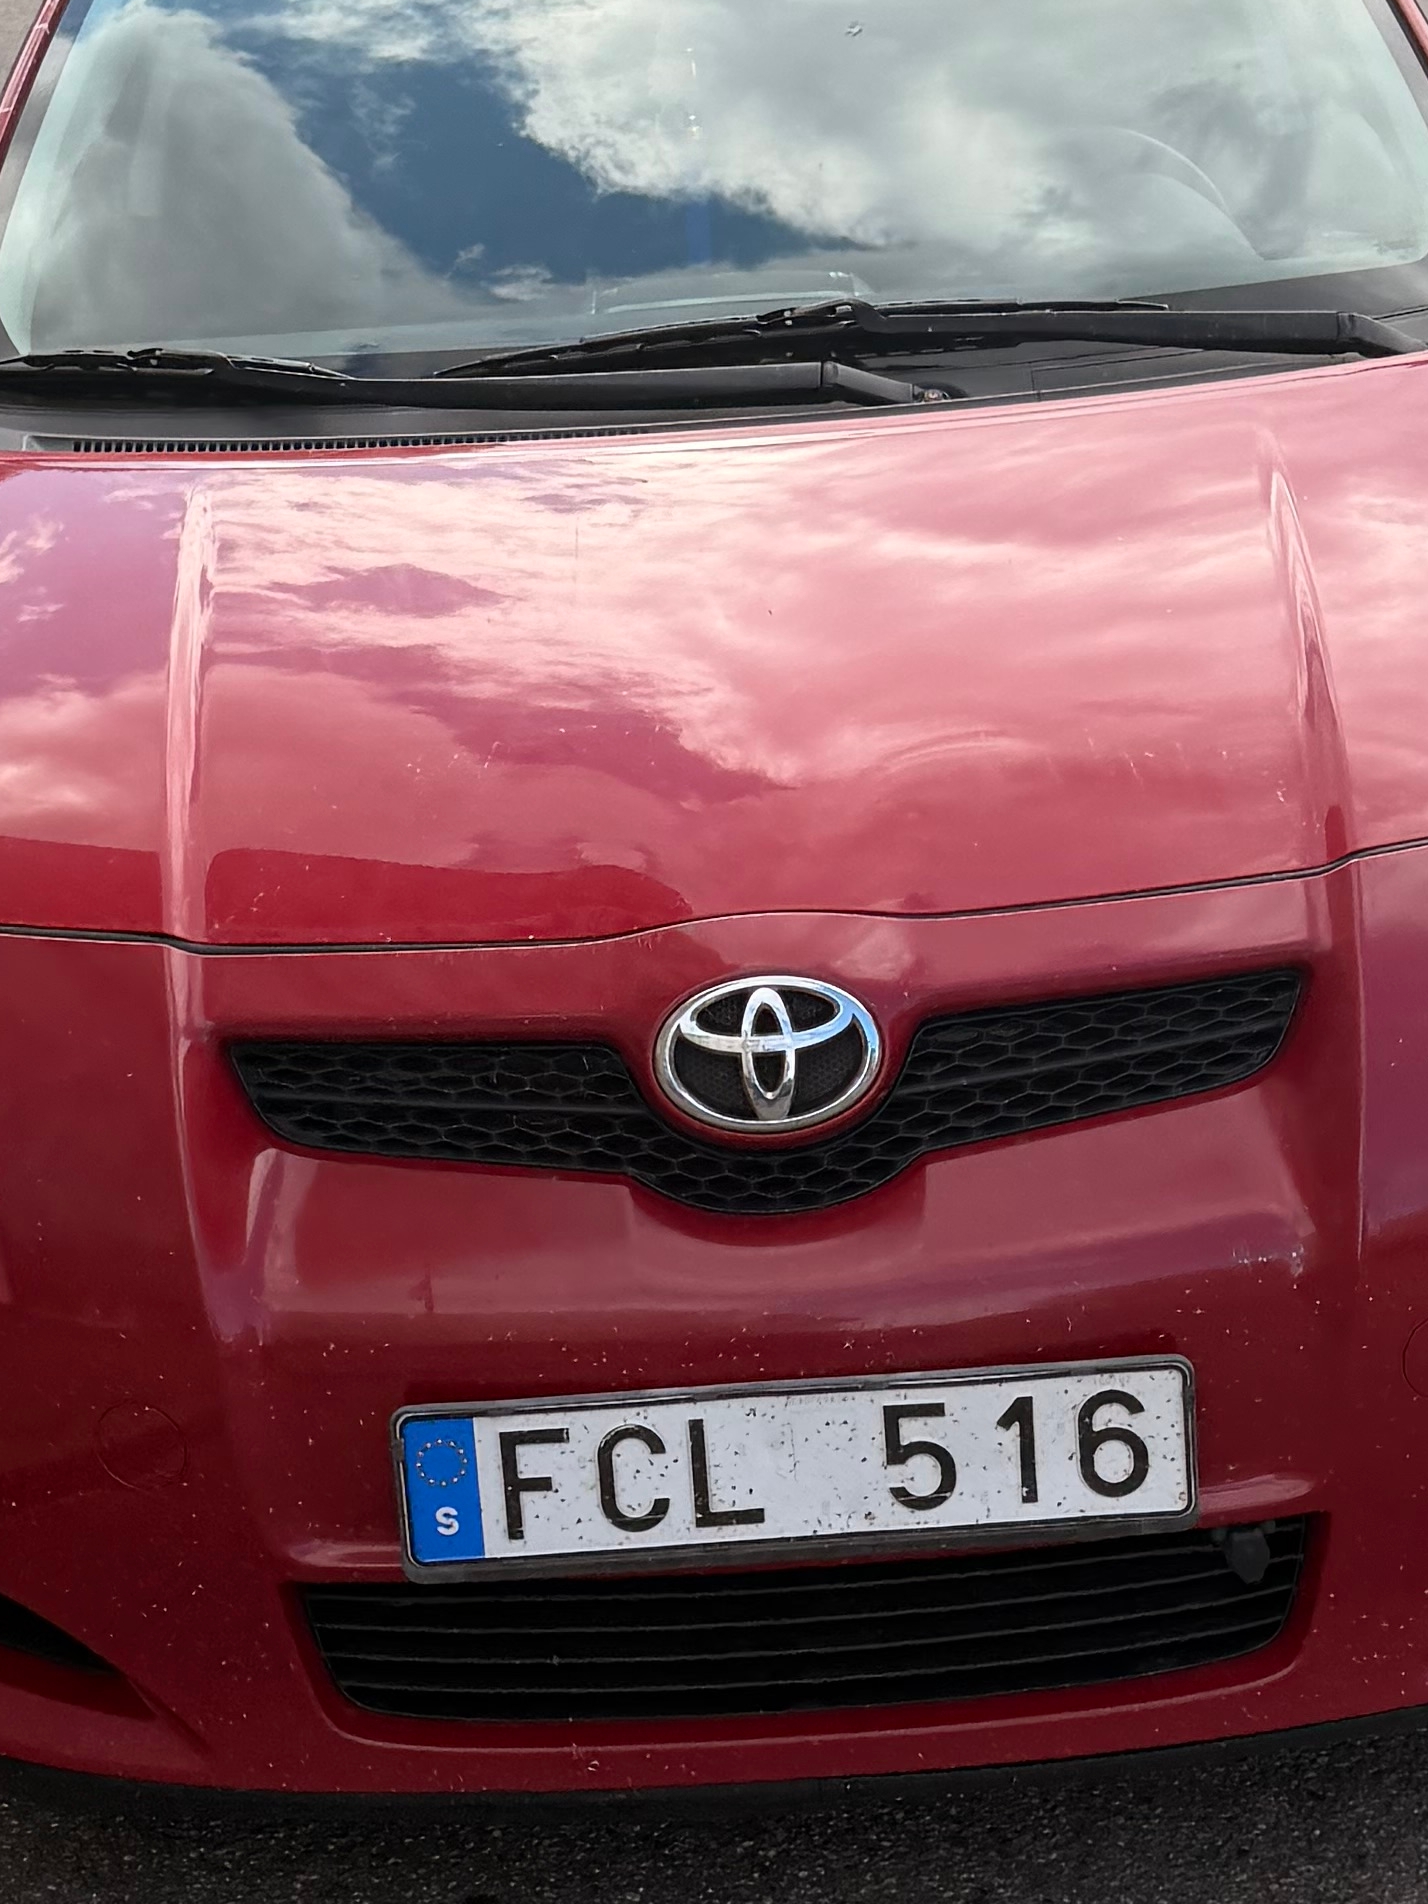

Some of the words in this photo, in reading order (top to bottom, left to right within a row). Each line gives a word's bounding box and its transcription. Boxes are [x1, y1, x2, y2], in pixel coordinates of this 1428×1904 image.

[499, 1419, 765, 1540] FCL
[883, 1389, 1149, 1511] 516
[435, 1506, 459, 1535] S
